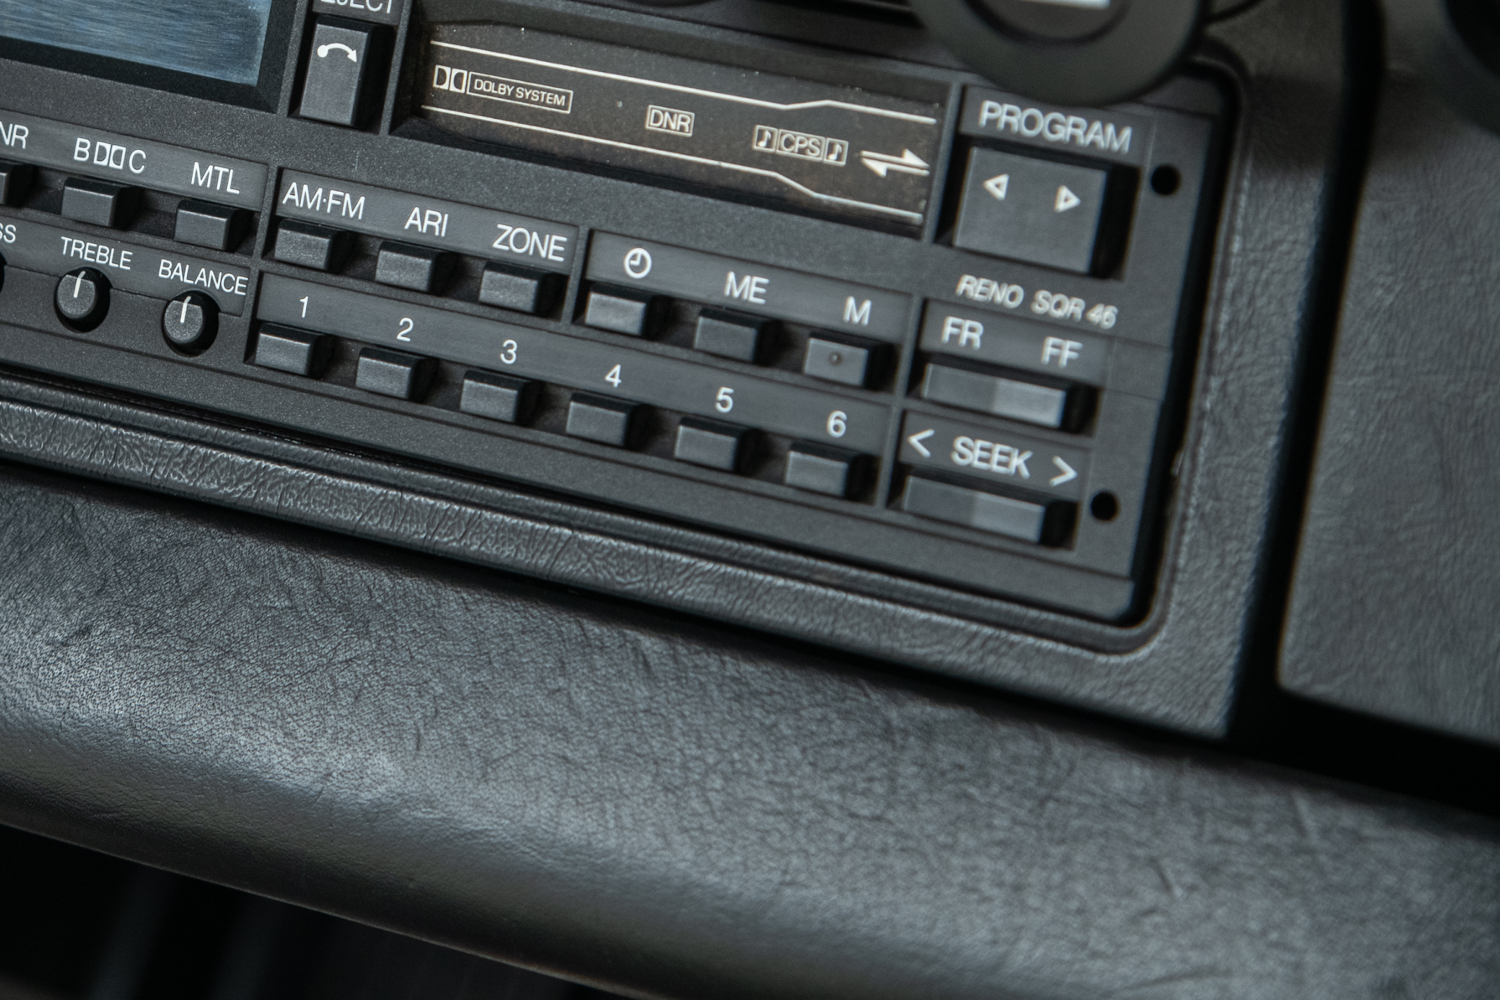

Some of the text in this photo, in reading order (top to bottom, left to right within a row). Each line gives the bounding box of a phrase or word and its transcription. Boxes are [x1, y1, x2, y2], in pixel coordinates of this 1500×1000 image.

[473, 78, 566, 107] DOLBY SYSTEM
[650, 109, 692, 132] DNR
[979, 100, 1132, 154] PROGRAM
[780, 133, 821, 157] CPS
[191, 162, 240, 195] MTL
[404, 207, 448, 237] ARI
[60, 236, 133, 270] TREBLE
[493, 224, 568, 262] ZONE
[158, 259, 249, 296] BALANCE
[724, 271, 770, 304] ME
[299, 296, 309, 318] 1
[843, 296, 872, 326] M
[955, 274, 1119, 330] RENO SQR 46
[396, 317, 414, 342] 2
[941, 316, 984, 349] FR
[500, 340, 518, 364] 3
[1040, 336, 1083, 367] FF
[604, 364, 622, 388] 4
[715, 386, 734, 413] 5
[826, 410, 847, 438] 6
[952, 435, 1033, 479] SEEK
